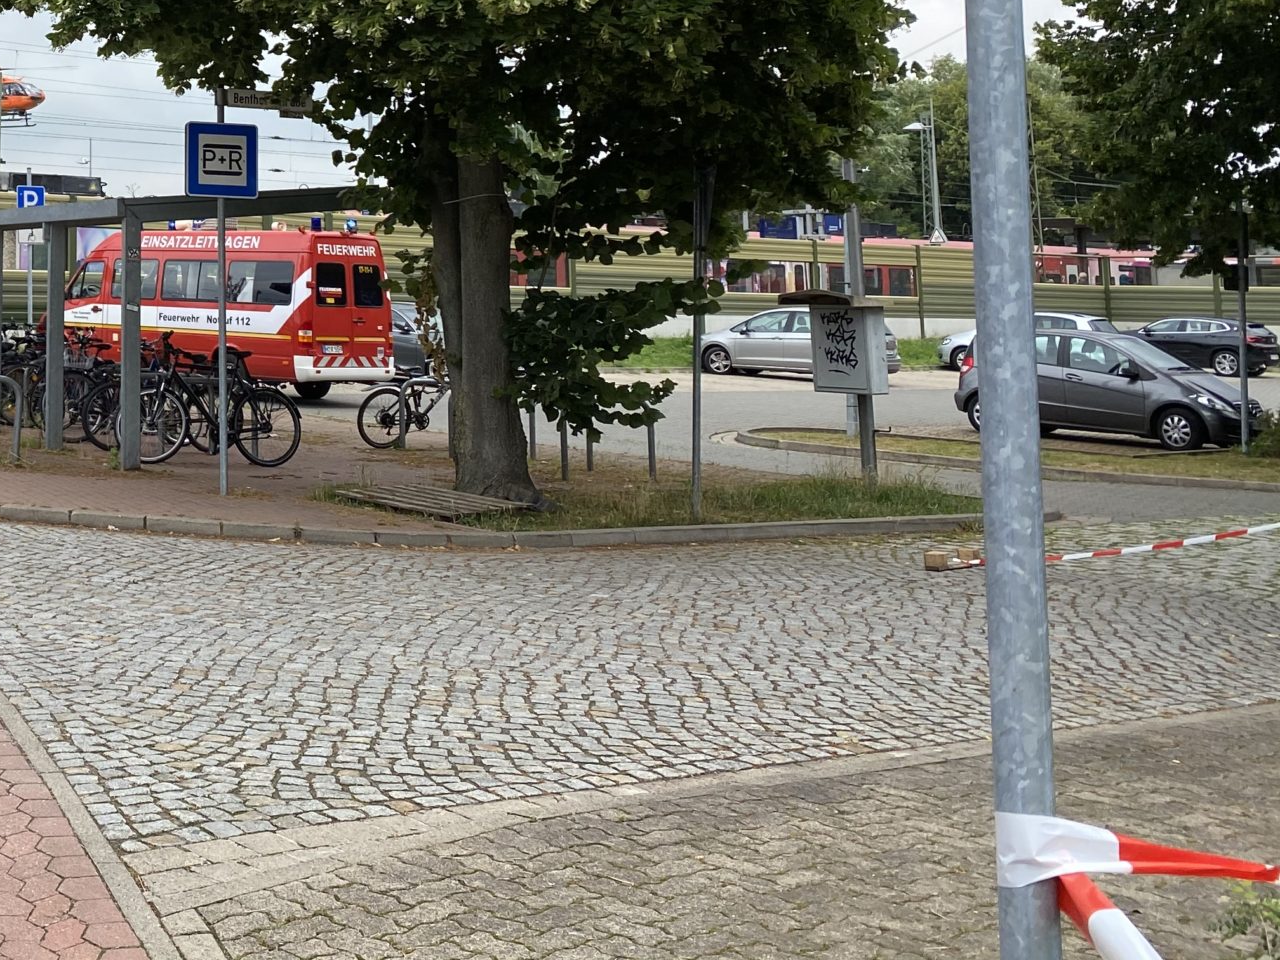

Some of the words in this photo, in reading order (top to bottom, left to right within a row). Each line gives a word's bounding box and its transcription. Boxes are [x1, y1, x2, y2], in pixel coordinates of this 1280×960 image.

[202, 149, 243, 171] P+R
[23, 190, 39, 208] P
[317, 243, 376, 257] FEUERWEHR
[159, 312, 200, 323] Feuerwehr
[236, 316, 251, 326] 112
